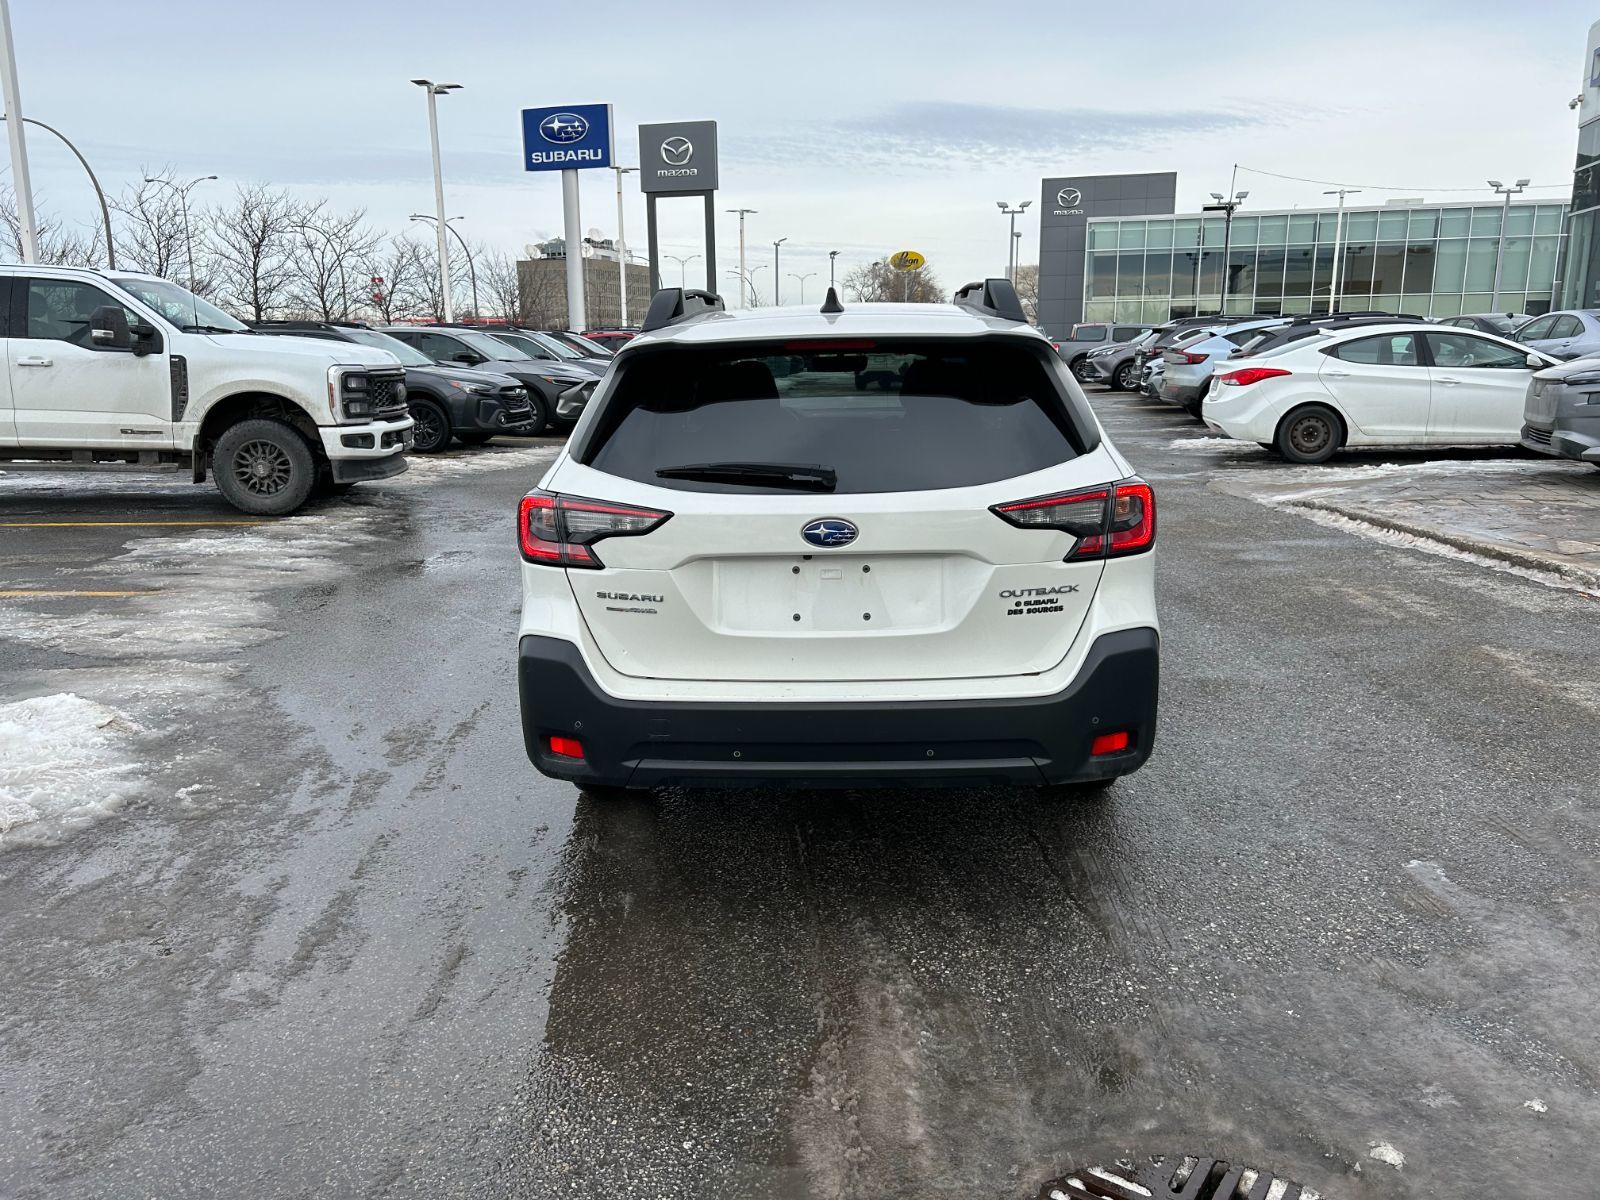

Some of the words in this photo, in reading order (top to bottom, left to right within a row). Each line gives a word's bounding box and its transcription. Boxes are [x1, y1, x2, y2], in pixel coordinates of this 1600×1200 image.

[531, 148, 602, 164] SUBARU
[657, 168, 698, 178] mazda
[999, 584, 1079, 598] OUTBACK
[596, 591, 664, 603] SUBARU
[1023, 598, 1059, 607] SUBARU
[1007, 608, 1024, 616] DES
[1026, 605, 1064, 614] SOURCES
